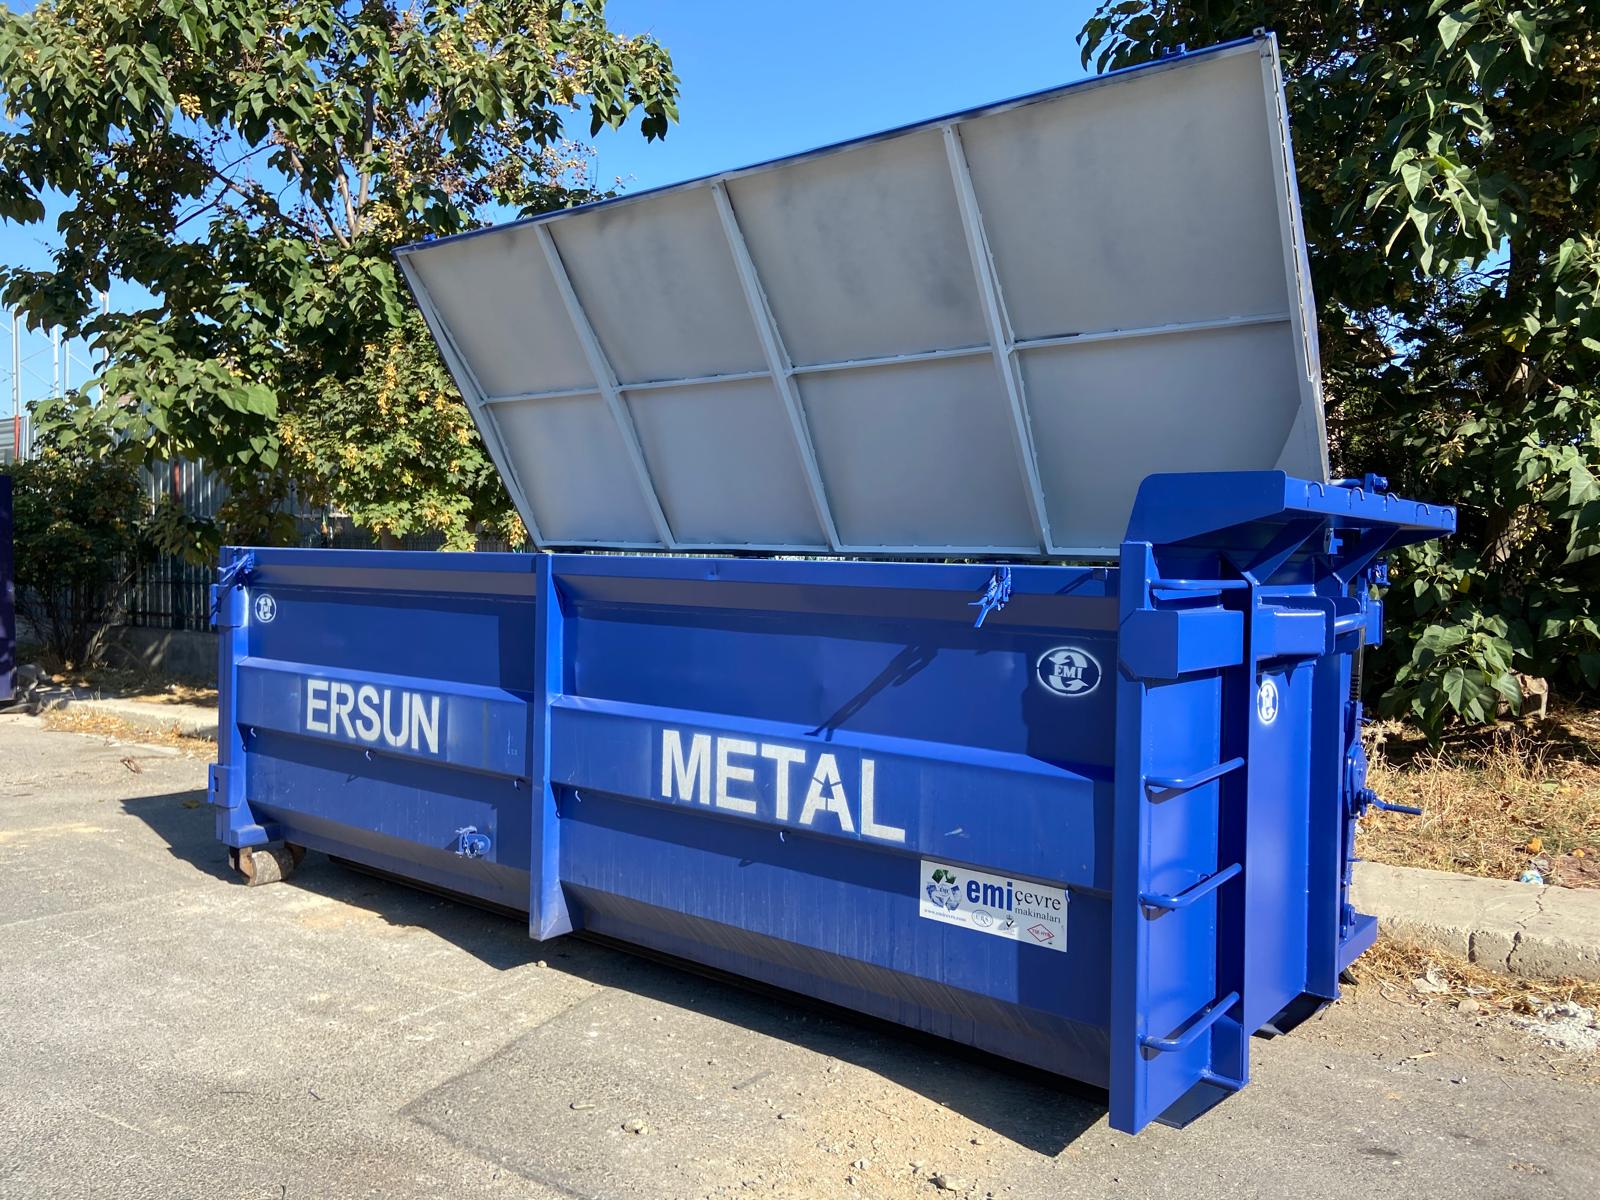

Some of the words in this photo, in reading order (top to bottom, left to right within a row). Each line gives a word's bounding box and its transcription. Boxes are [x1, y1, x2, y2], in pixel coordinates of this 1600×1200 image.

[1054, 664, 1083, 679] EMI
[306, 678, 440, 754] ERSUN
[661, 729, 906, 843] METAL
[966, 879, 1013, 911] emi
[1014, 890, 1061, 911] çevre
